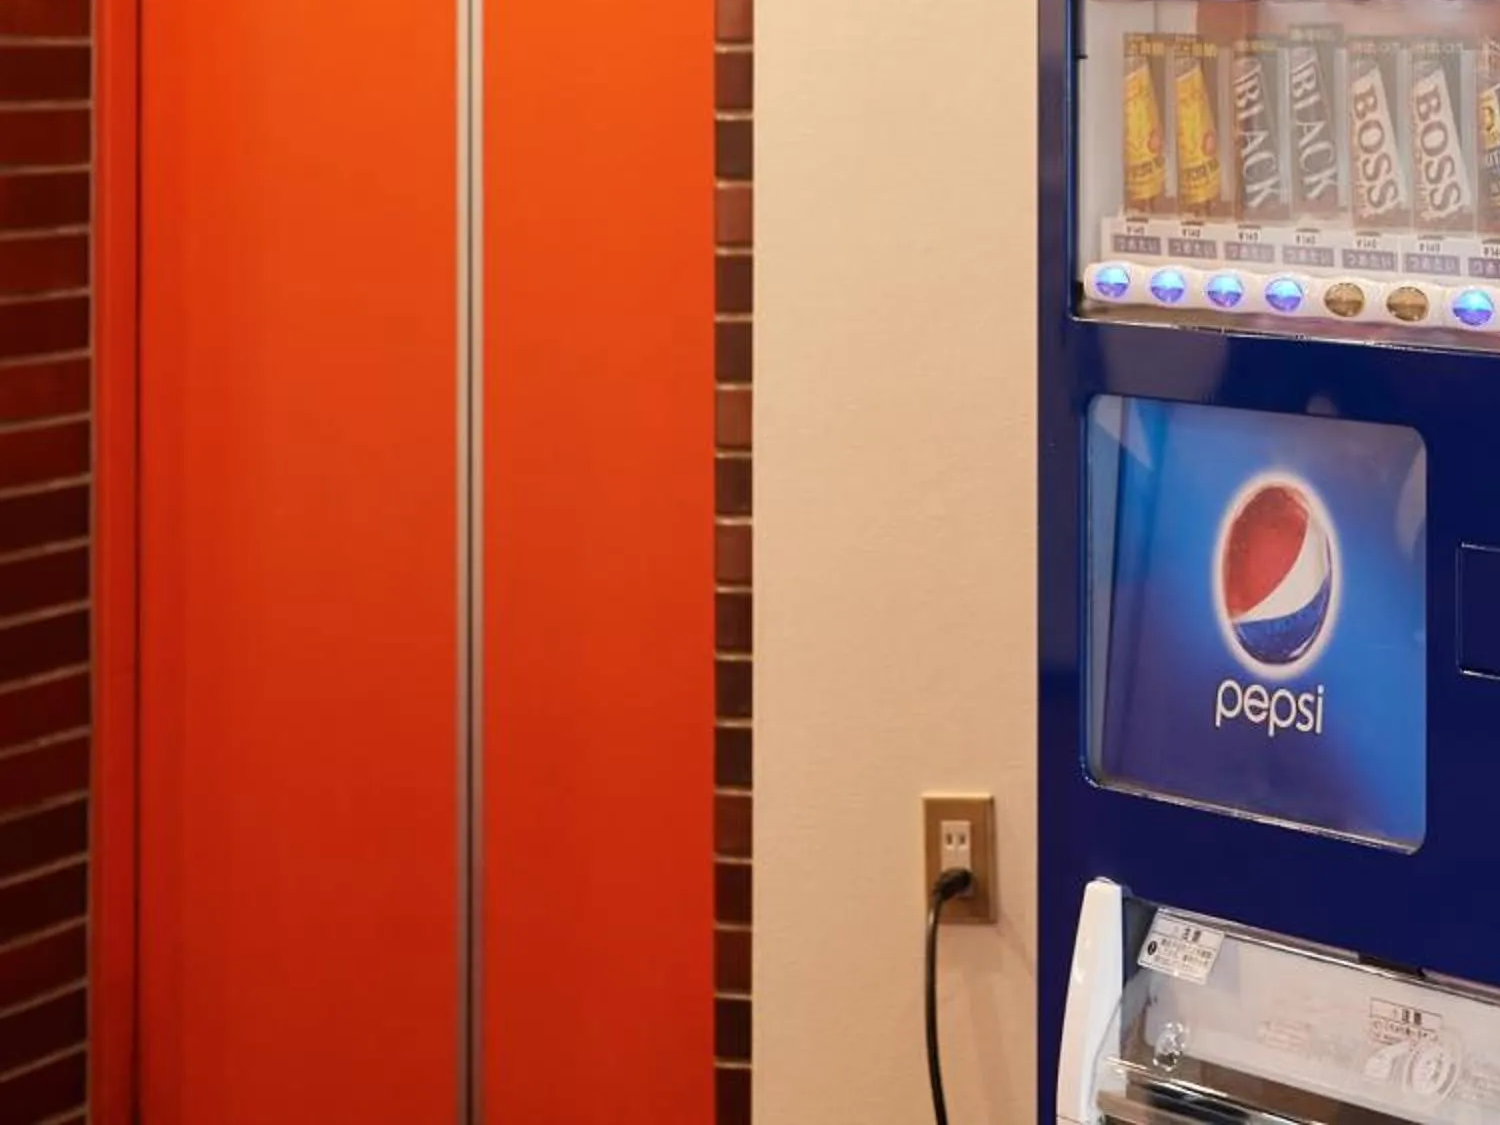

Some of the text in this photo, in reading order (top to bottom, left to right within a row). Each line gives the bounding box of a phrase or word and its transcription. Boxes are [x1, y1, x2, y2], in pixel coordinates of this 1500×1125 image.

[1353, 83, 1398, 209] BOSS
[1415, 84, 1461, 211] BOSS
[1215, 679, 1325, 737] pepsi
